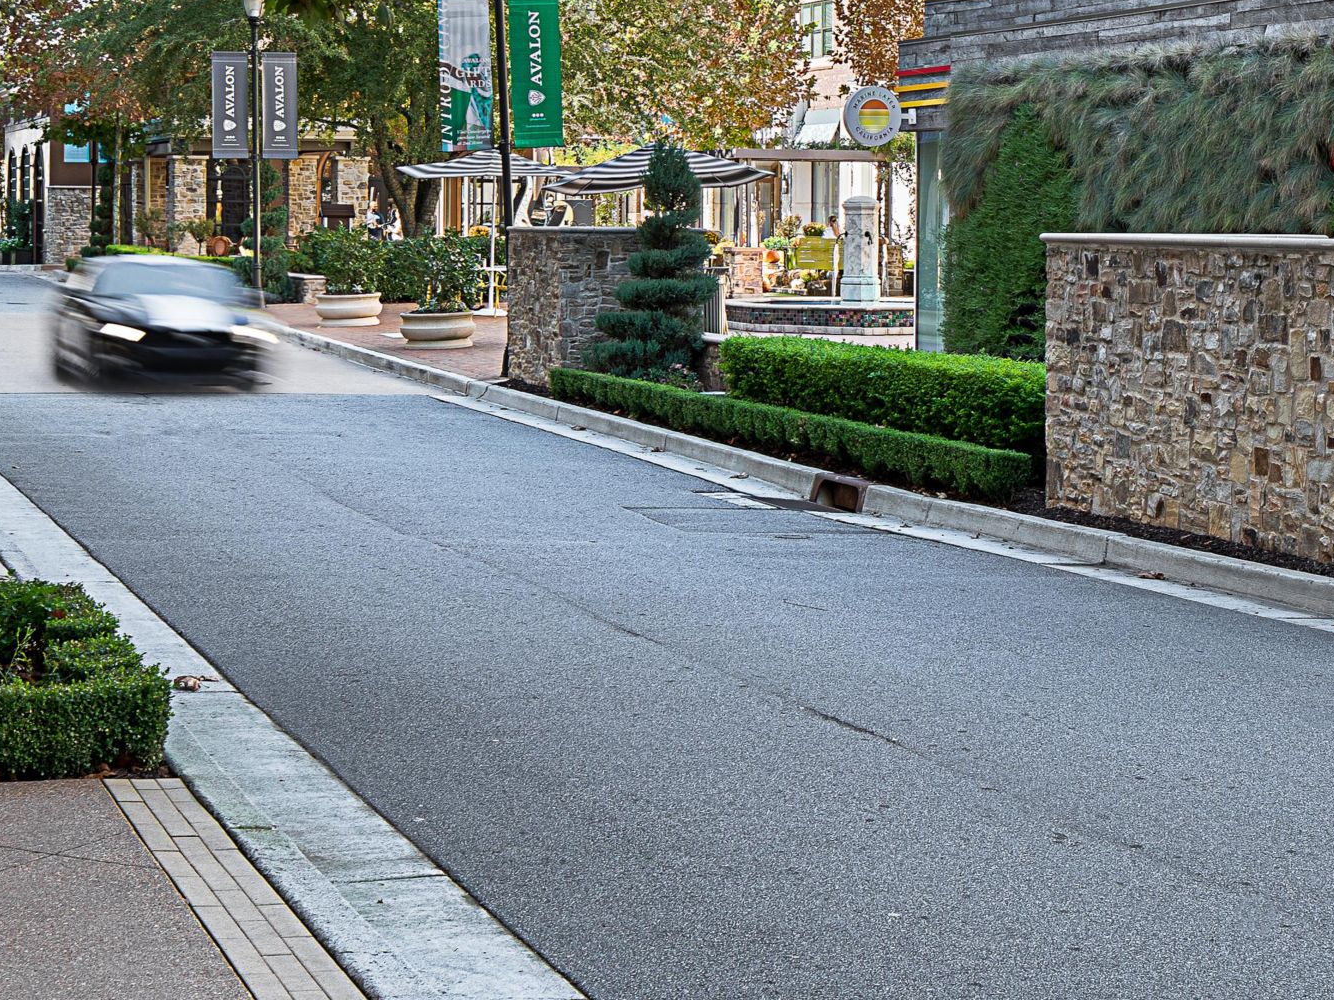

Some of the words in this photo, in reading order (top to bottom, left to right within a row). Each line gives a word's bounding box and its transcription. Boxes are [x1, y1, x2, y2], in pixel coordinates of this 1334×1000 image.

[528, 10, 542, 86] AVALON
[455, 66, 491, 78] GIFT
[225, 65, 235, 118] AVALON
[274, 66, 285, 118] AVALON
[458, 80, 491, 88] ARDS
[853, 90, 876, 110] MARINE
[855, 126, 894, 141] CALIFORNIA
